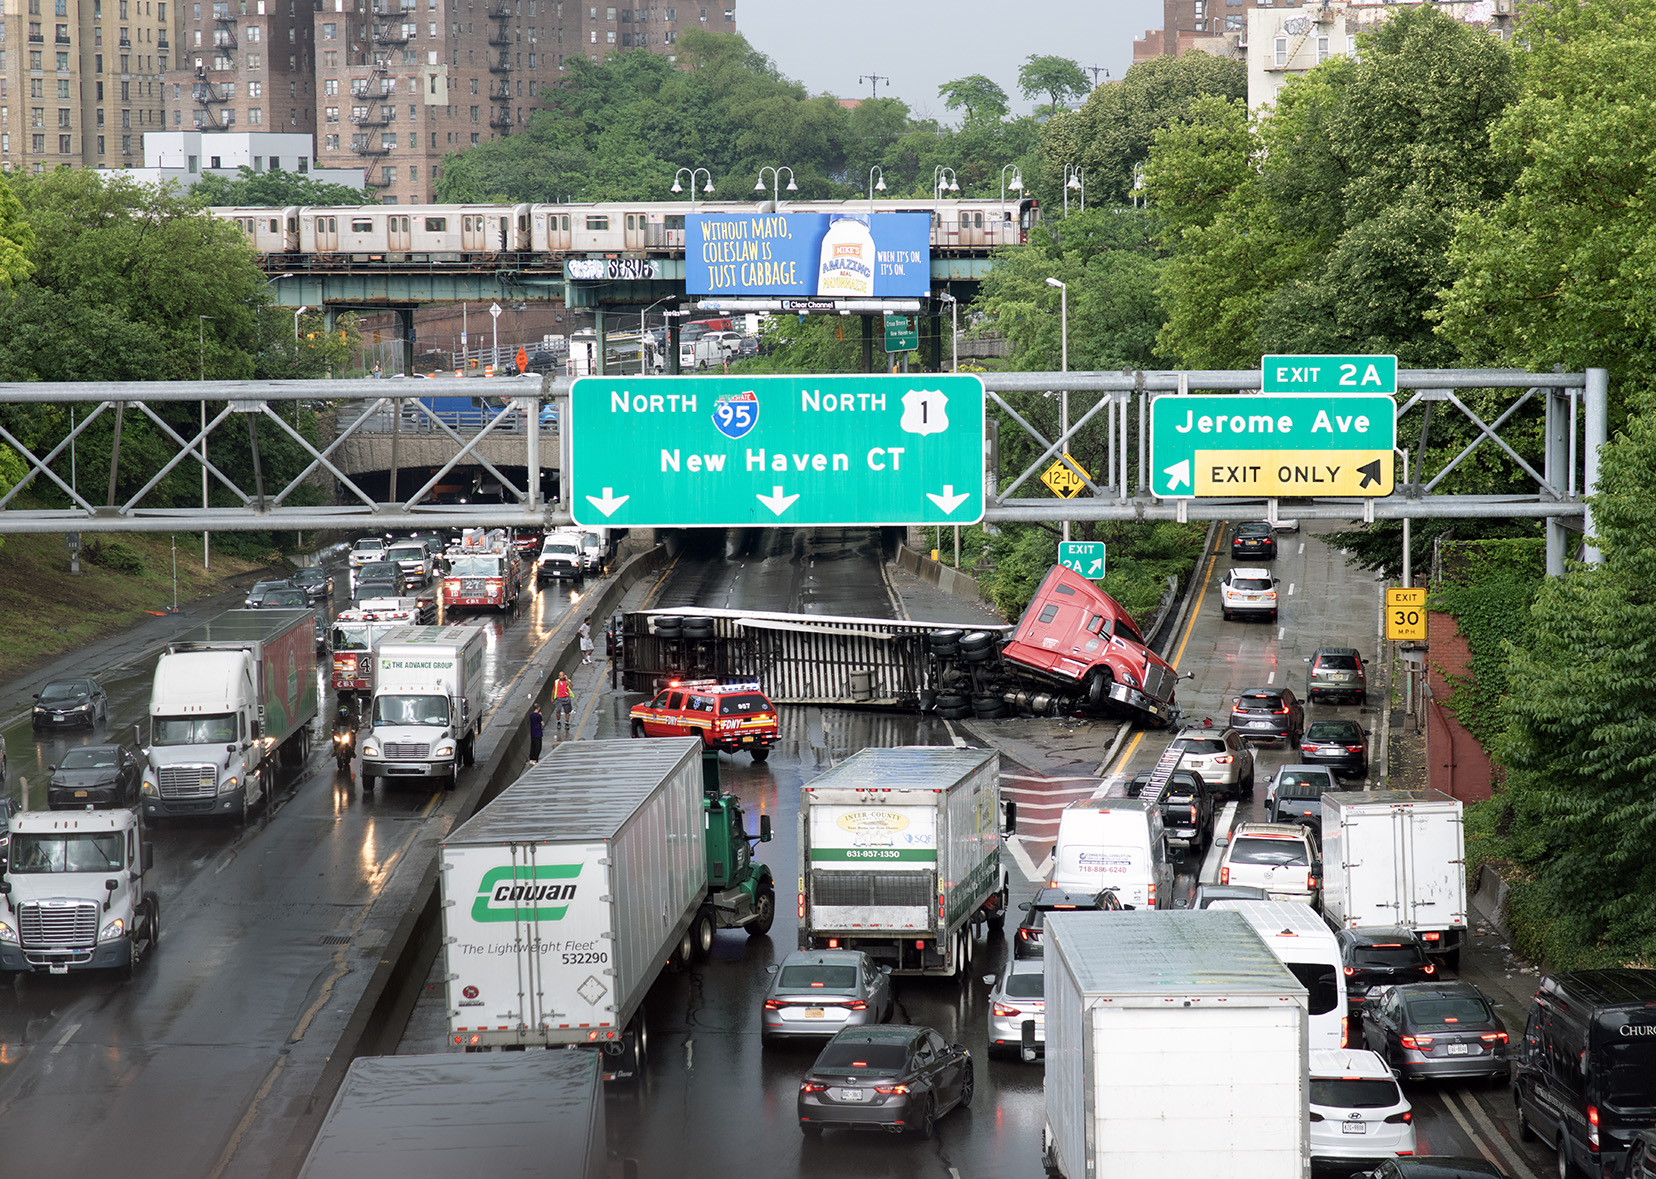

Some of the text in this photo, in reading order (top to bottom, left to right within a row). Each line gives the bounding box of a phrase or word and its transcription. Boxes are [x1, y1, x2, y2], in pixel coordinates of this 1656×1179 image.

[701, 216, 792, 242] WITHOUT MAYO,
[702, 240, 772, 263] COLESLAW IS
[836, 246, 860, 255] MIKE'S
[877, 250, 922, 264] WHEN IT'S ON,
[708, 261, 804, 290] JUST CABBAGE.
[822, 259, 870, 278] AMAZING
[880, 264, 906, 276] IT'S ON.
[822, 278, 867, 293] MAYONNAISE
[790, 300, 834, 309] Clear Channel
[1276, 364, 1382, 386] EXIT 2A
[612, 391, 697, 413] NORTH
[802, 390, 886, 412] NORTH
[718, 405, 751, 428] 95
[920, 400, 928, 424] 1
[1175, 410, 1370, 434] Jerome Ave
[660, 447, 905, 472] New Haven CT
[1049, 472, 1080, 485] 12-10
[1212, 466, 1341, 482] EXIT ONLY
[1068, 544, 1094, 554] EXIT
[1063, 560, 1083, 573] 2A
[466, 580, 480, 590] 27
[1394, 611, 1419, 625] 30
[665, 715, 678, 726] FDNY
[722, 719, 742, 730] FDNY
[914, 834, 932, 844] SQF
[488, 941, 561, 956] Lightweight
[562, 953, 608, 965] 532290
